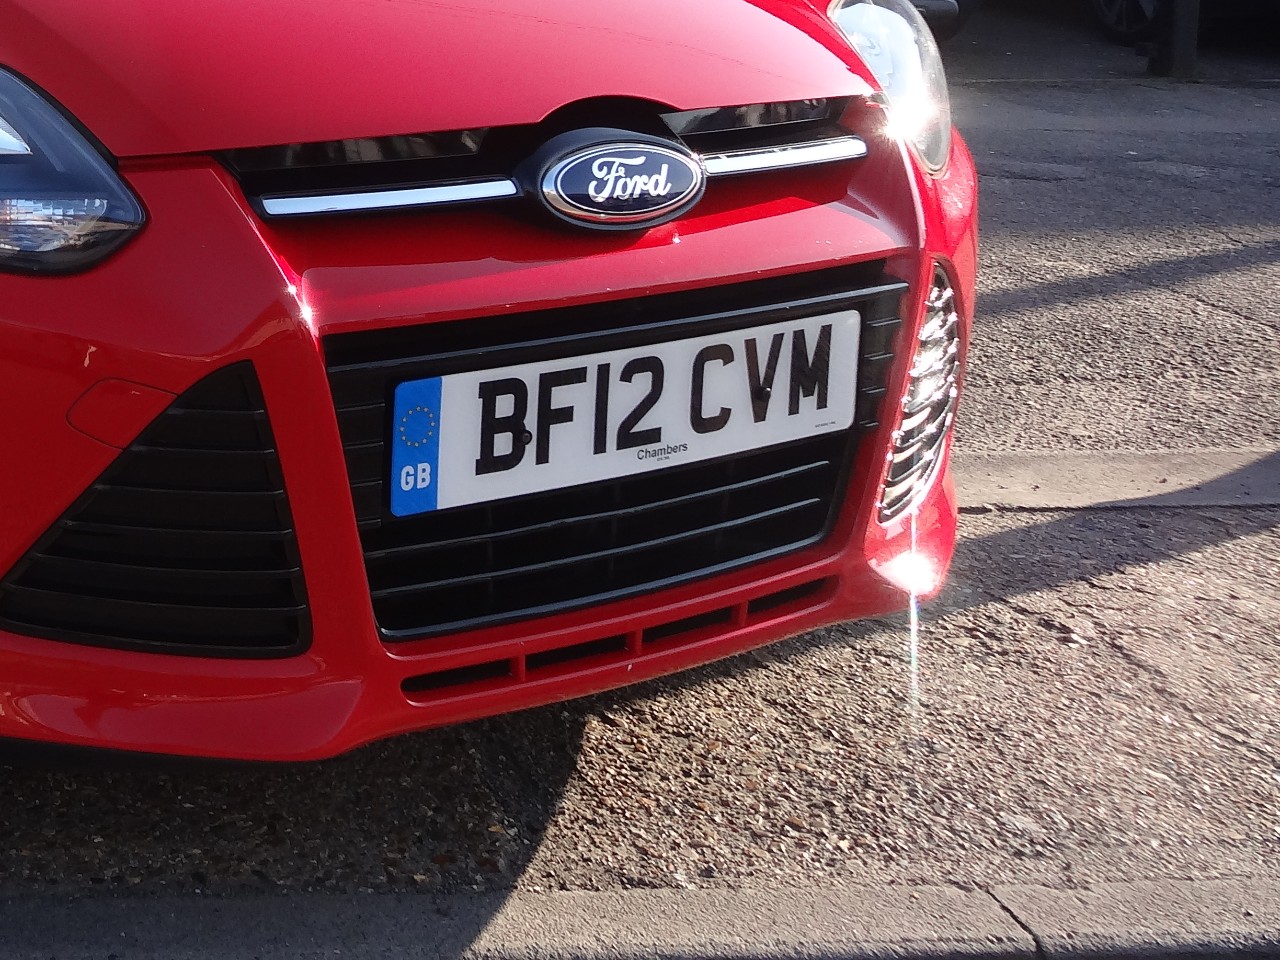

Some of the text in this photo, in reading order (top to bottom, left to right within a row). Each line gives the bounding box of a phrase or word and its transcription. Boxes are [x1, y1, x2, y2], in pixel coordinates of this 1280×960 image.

[587, 155, 673, 203] Ford
[474, 323, 834, 477] BF12 CVM
[637, 442, 689, 460] Chambers
[400, 462, 432, 492] GB
